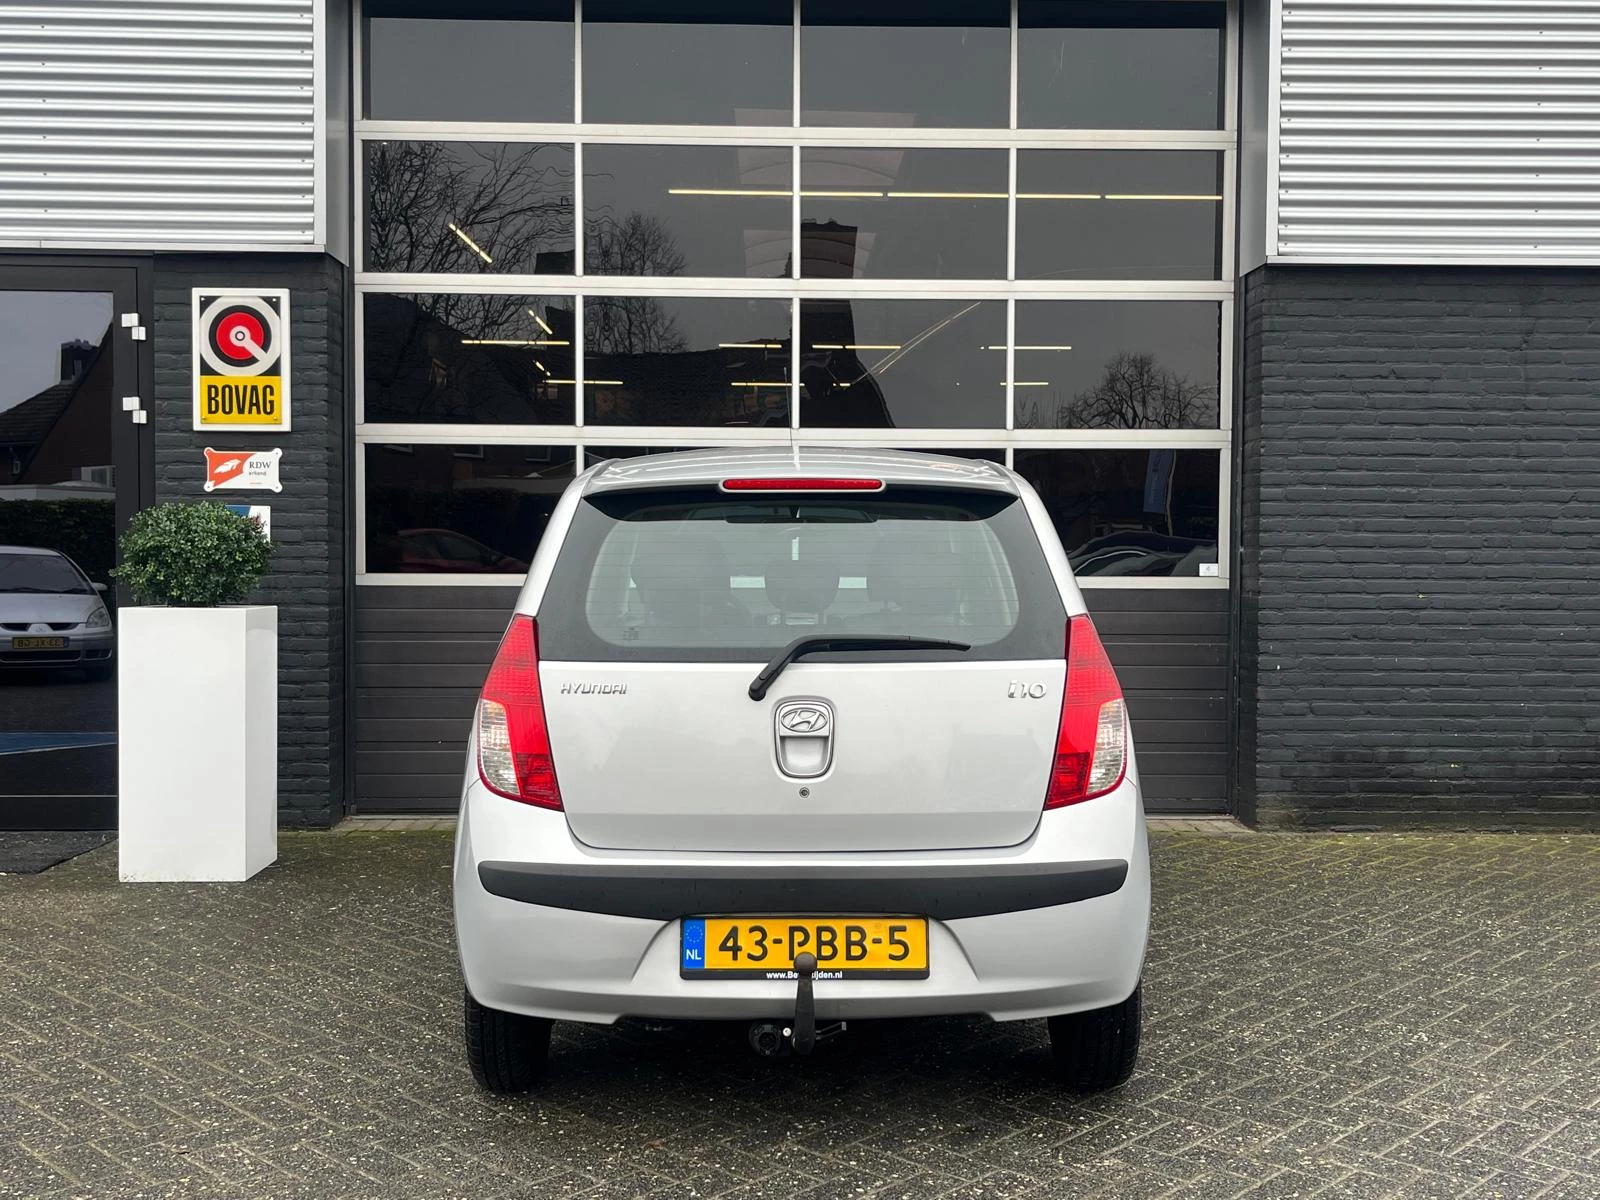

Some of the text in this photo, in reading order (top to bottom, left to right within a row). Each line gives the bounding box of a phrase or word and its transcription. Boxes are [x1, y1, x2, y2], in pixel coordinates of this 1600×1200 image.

[207, 384, 275, 415] BOVAG
[249, 461, 271, 469] RDW
[560, 682, 627, 695] HYUNDAI
[1008, 680, 1047, 699] i10
[718, 925, 910, 961] 43-PBB-5
[686, 949, 702, 960] NL
